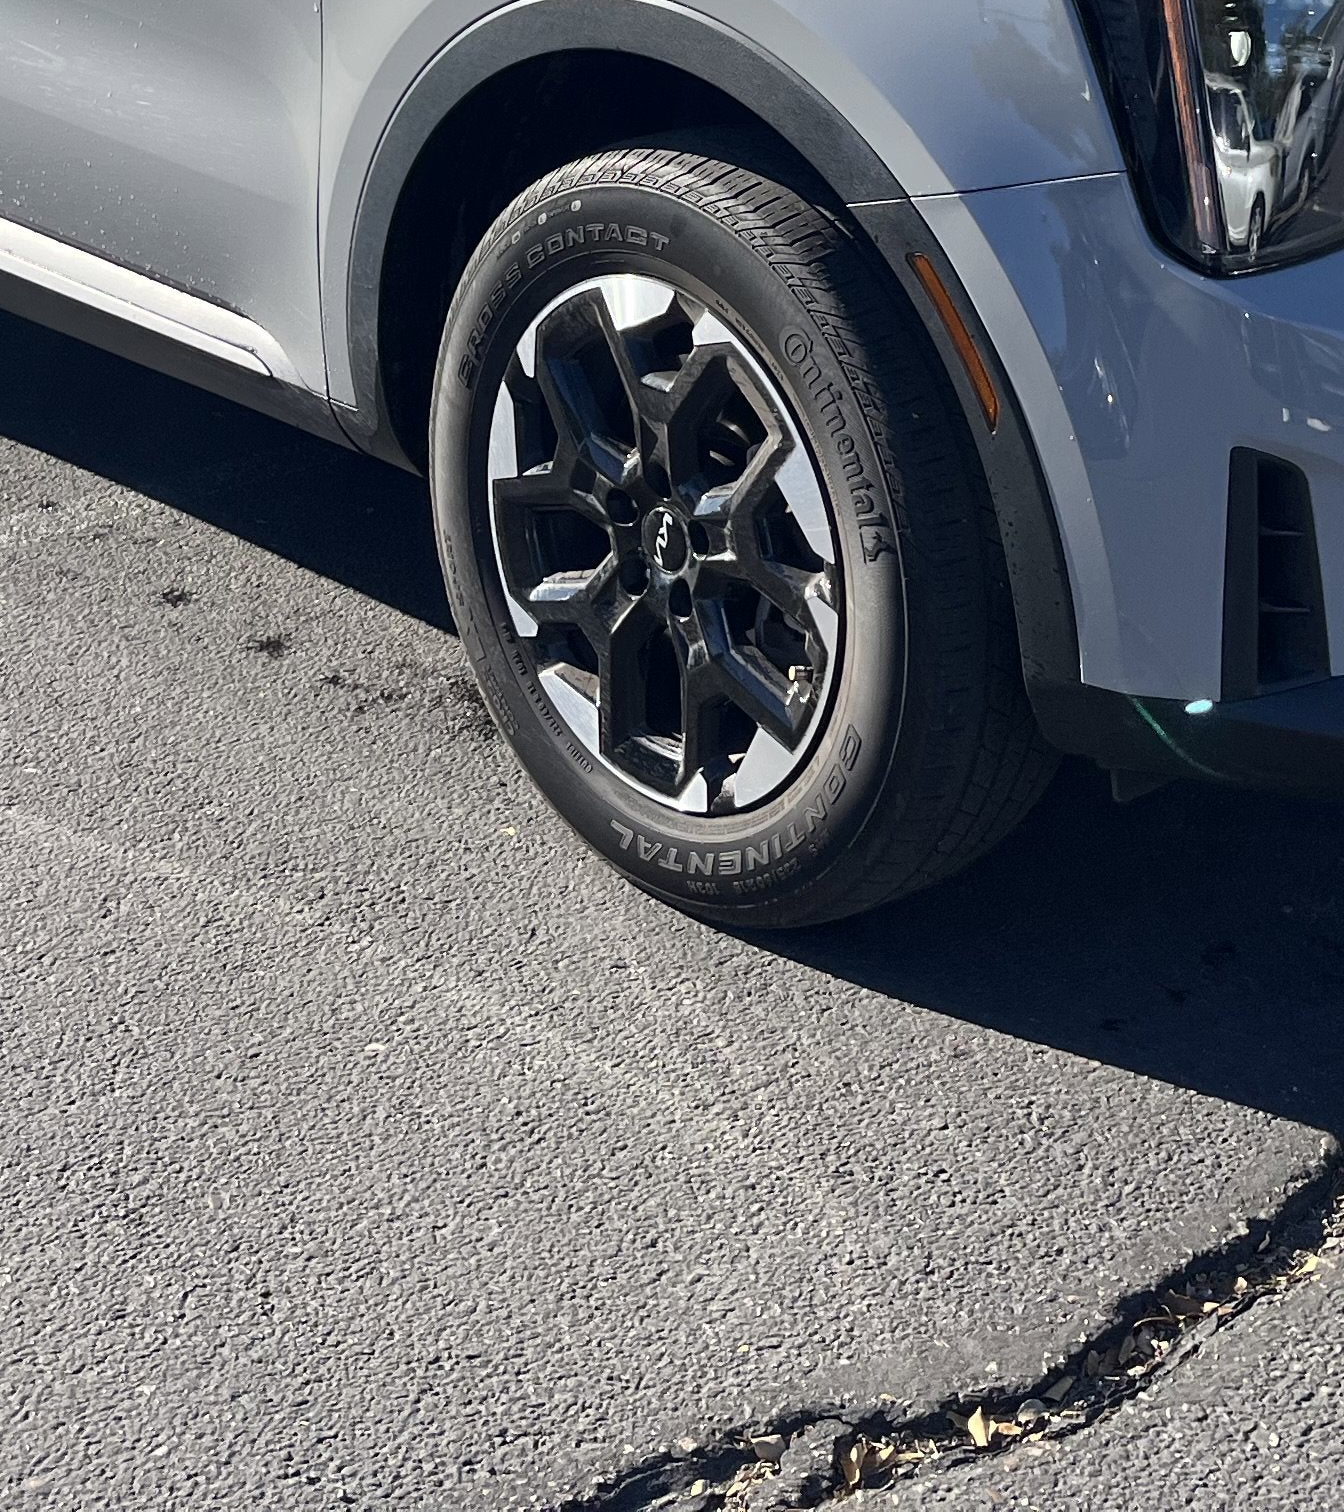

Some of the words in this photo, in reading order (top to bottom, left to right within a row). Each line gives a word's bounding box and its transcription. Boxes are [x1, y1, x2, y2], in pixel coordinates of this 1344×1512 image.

[457, 262, 523, 388] CROSS
[524, 222, 671, 271] CONTACT
[783, 331, 889, 529] Continental
[609, 723, 862, 876] CONTINENTAL
